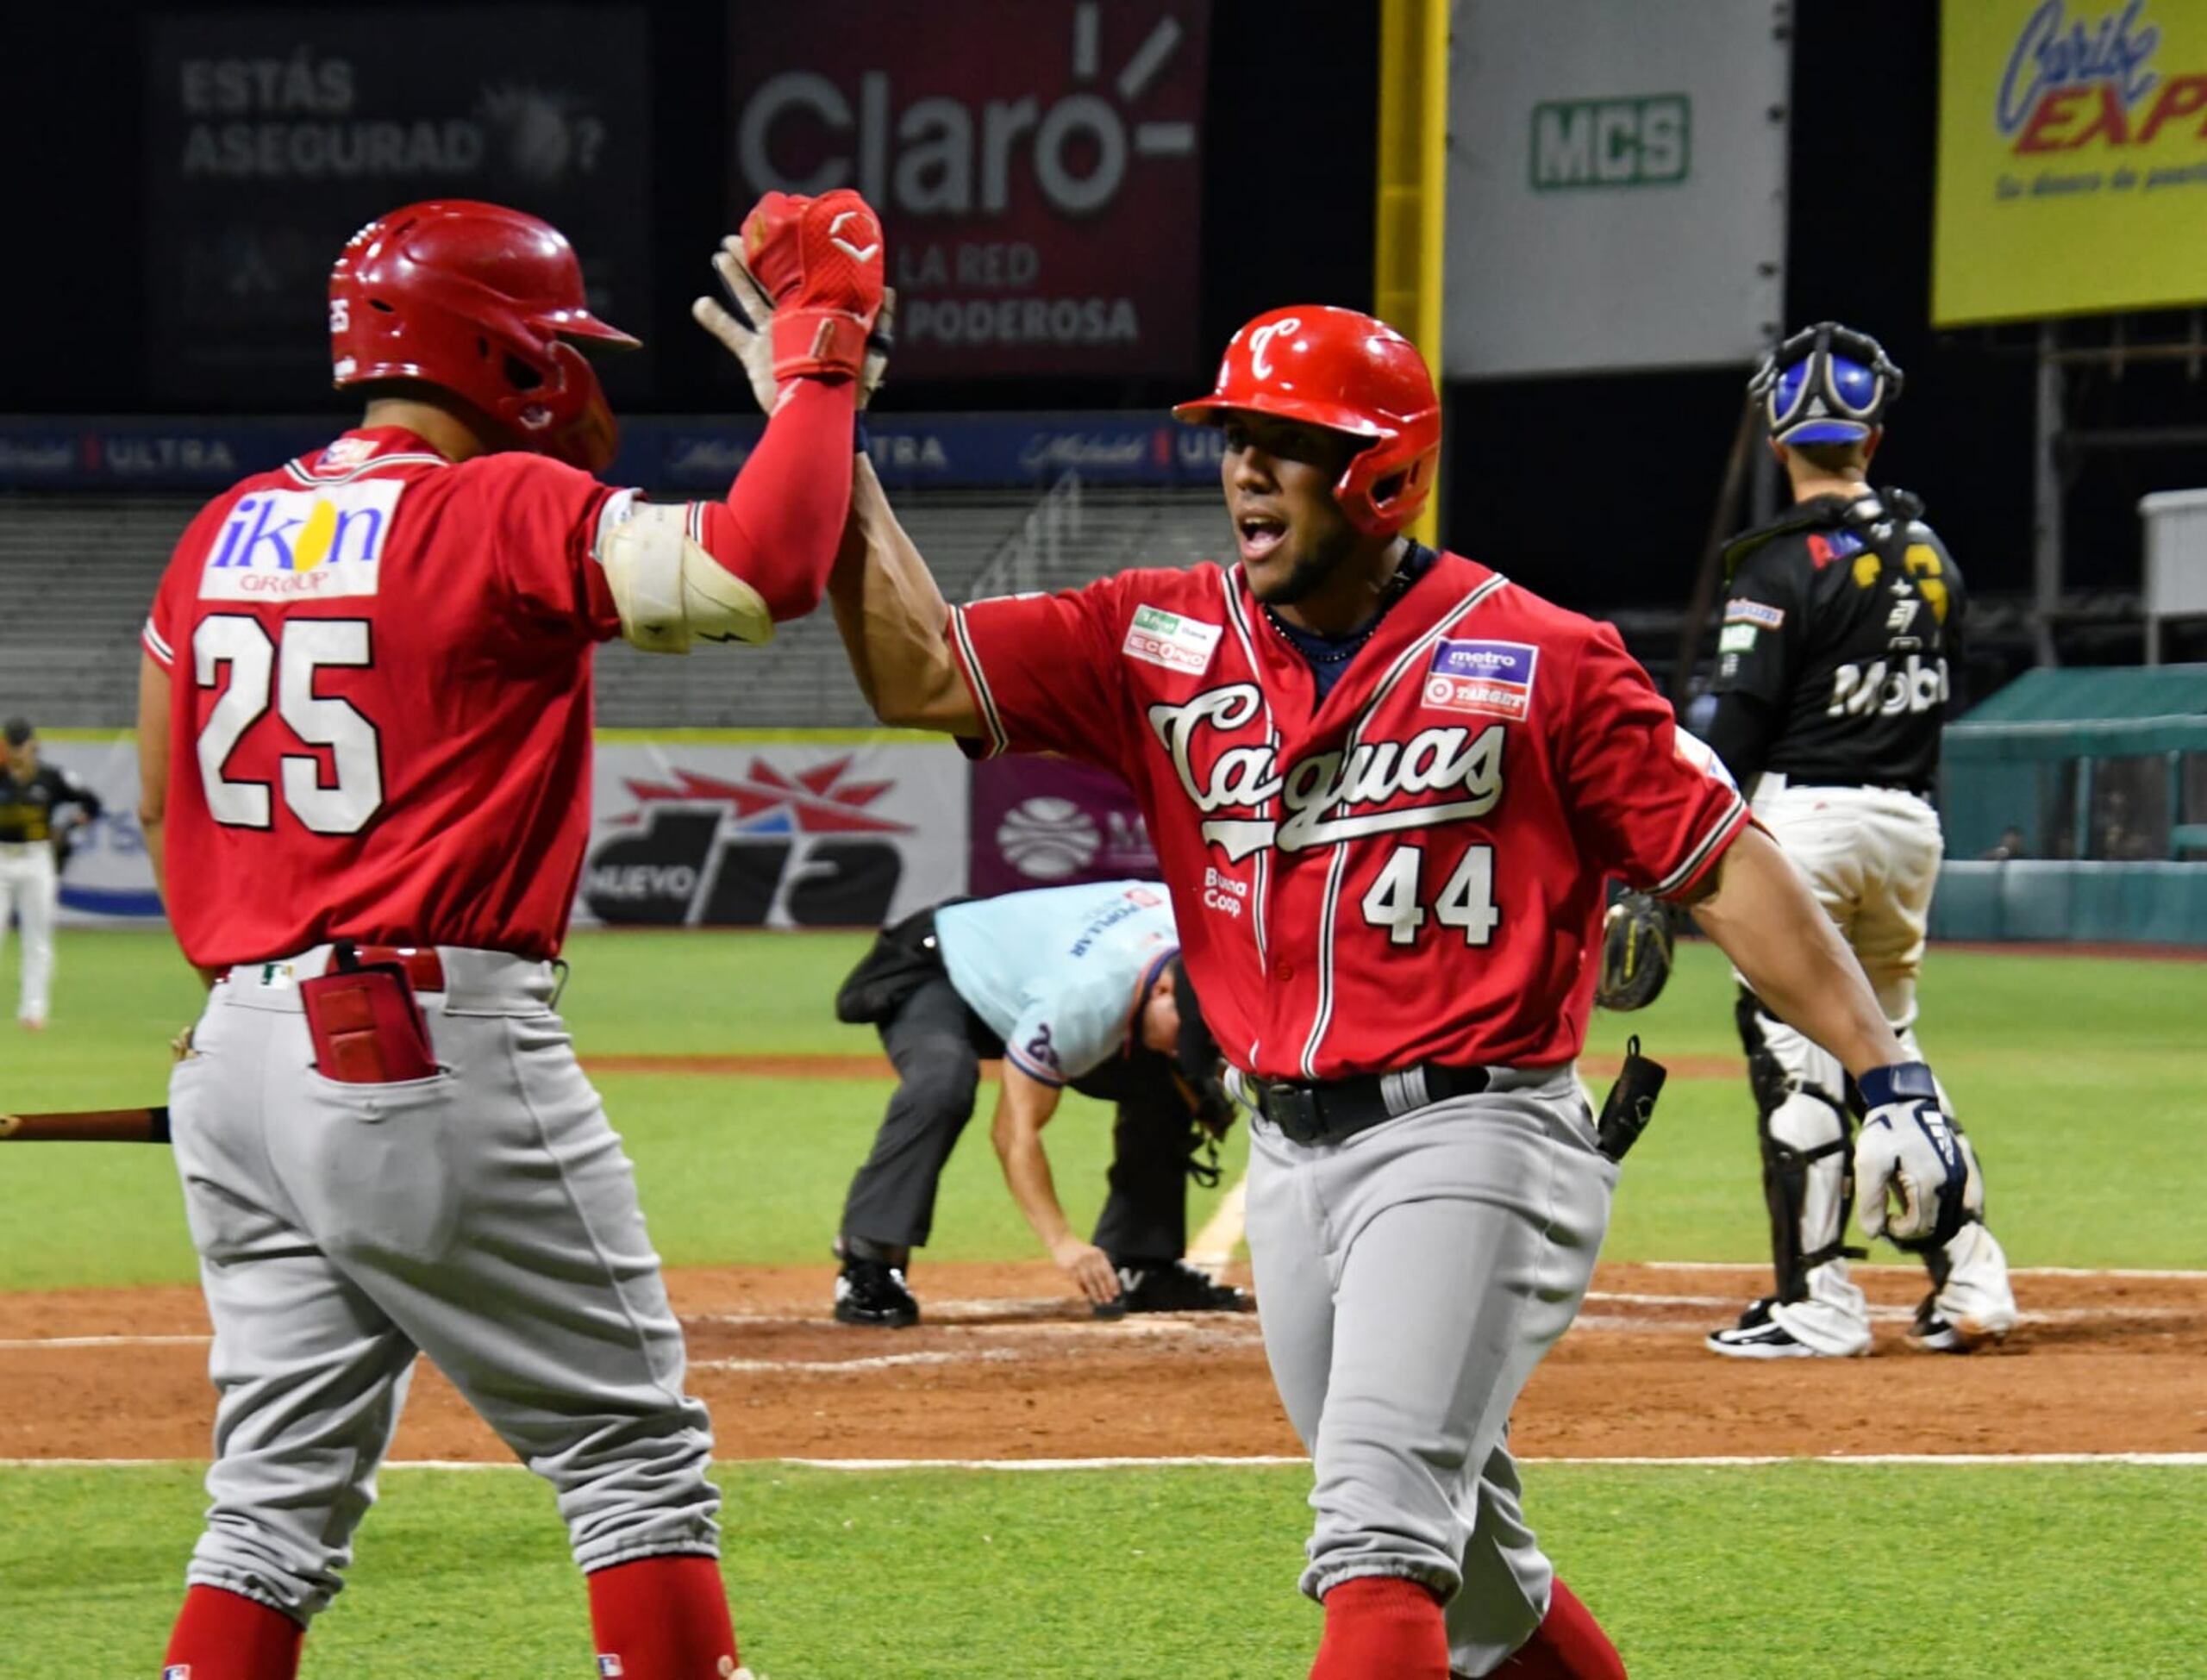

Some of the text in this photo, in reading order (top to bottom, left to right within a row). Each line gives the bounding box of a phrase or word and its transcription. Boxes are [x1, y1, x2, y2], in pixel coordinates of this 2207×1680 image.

[180, 43, 356, 112] ESTÁS
[739, 71, 1128, 215] Claro
[1536, 99, 1686, 184] MCS
[897, 243, 1039, 283] LA RED
[906, 299, 1138, 340] PODEROSA
[107, 438, 234, 470] ULTRA
[871, 435, 947, 466] TRA
[240, 571, 329, 593] GROUP
[1449, 651, 1516, 667] metro
[191, 613, 385, 838] 25
[1147, 681, 1508, 855] Caguas
[1204, 889, 1241, 919] Coop
[1360, 843, 1499, 946] 44
